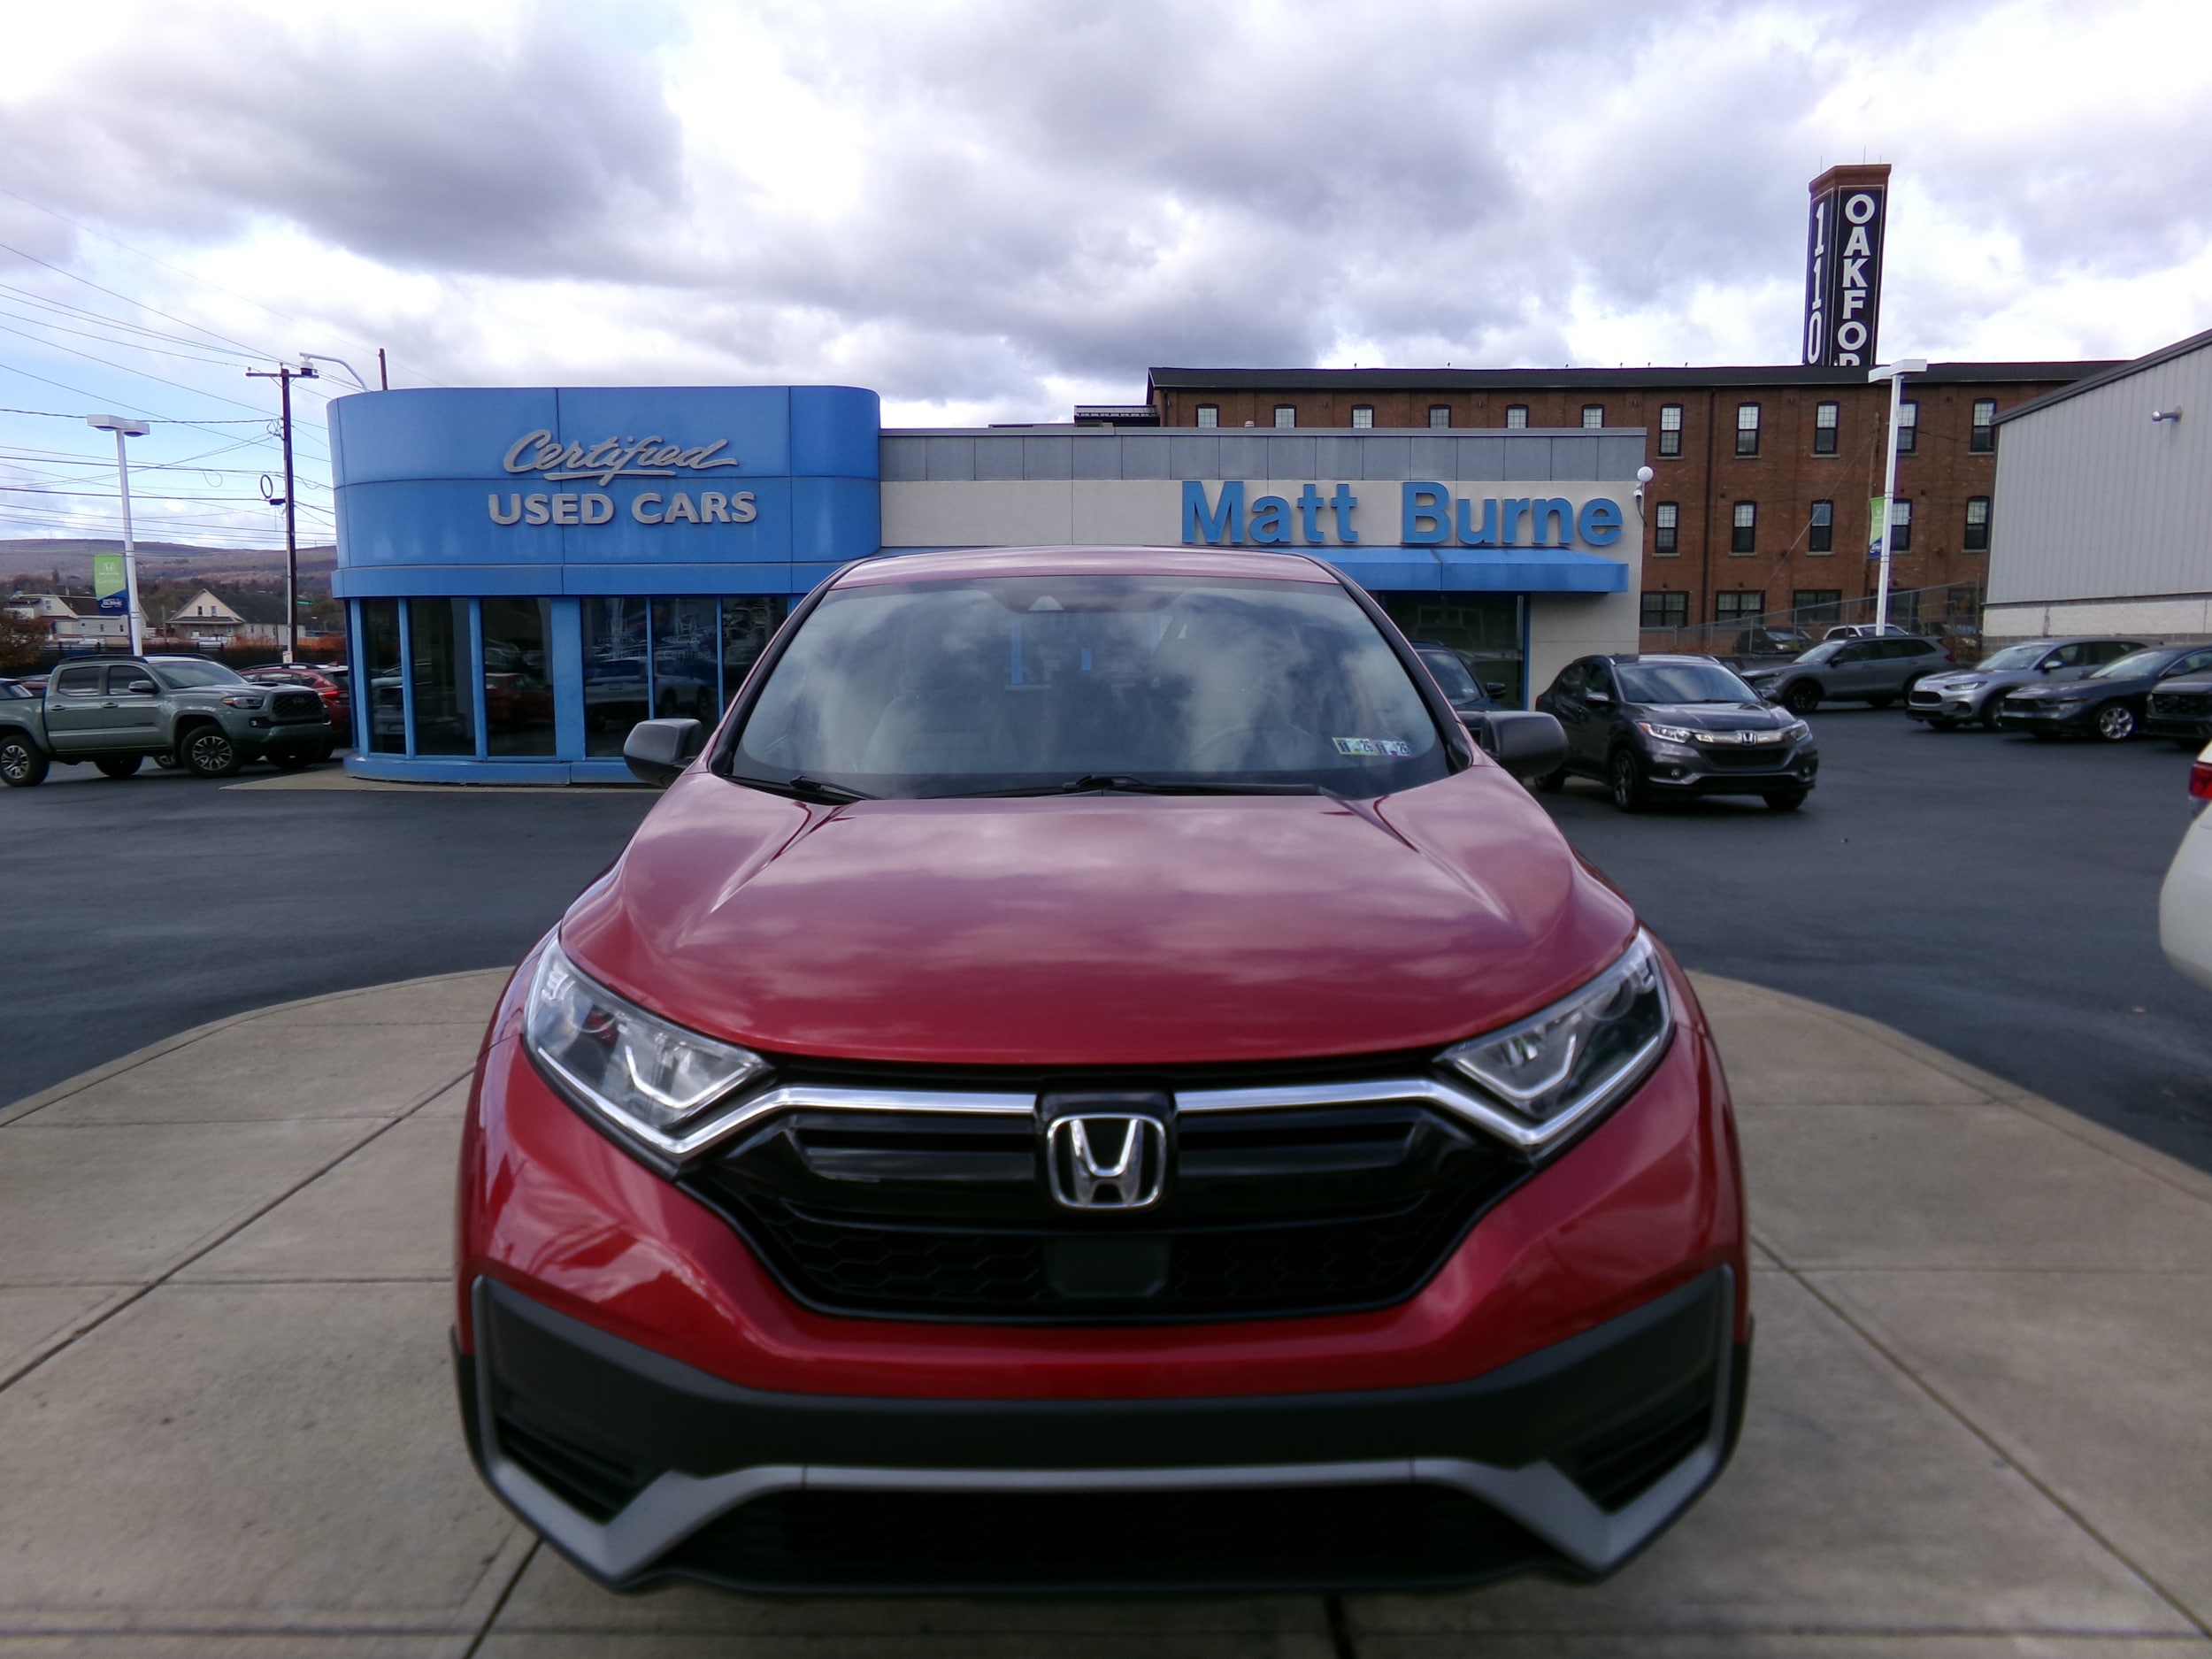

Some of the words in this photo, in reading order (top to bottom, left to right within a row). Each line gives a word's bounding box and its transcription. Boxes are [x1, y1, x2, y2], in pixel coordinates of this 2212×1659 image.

[503, 429, 739, 487] Certified
[488, 493, 615, 526] USED
[632, 491, 757, 525] CARS
[1181, 480, 1359, 544] Matt
[1401, 481, 1624, 546] Burne
